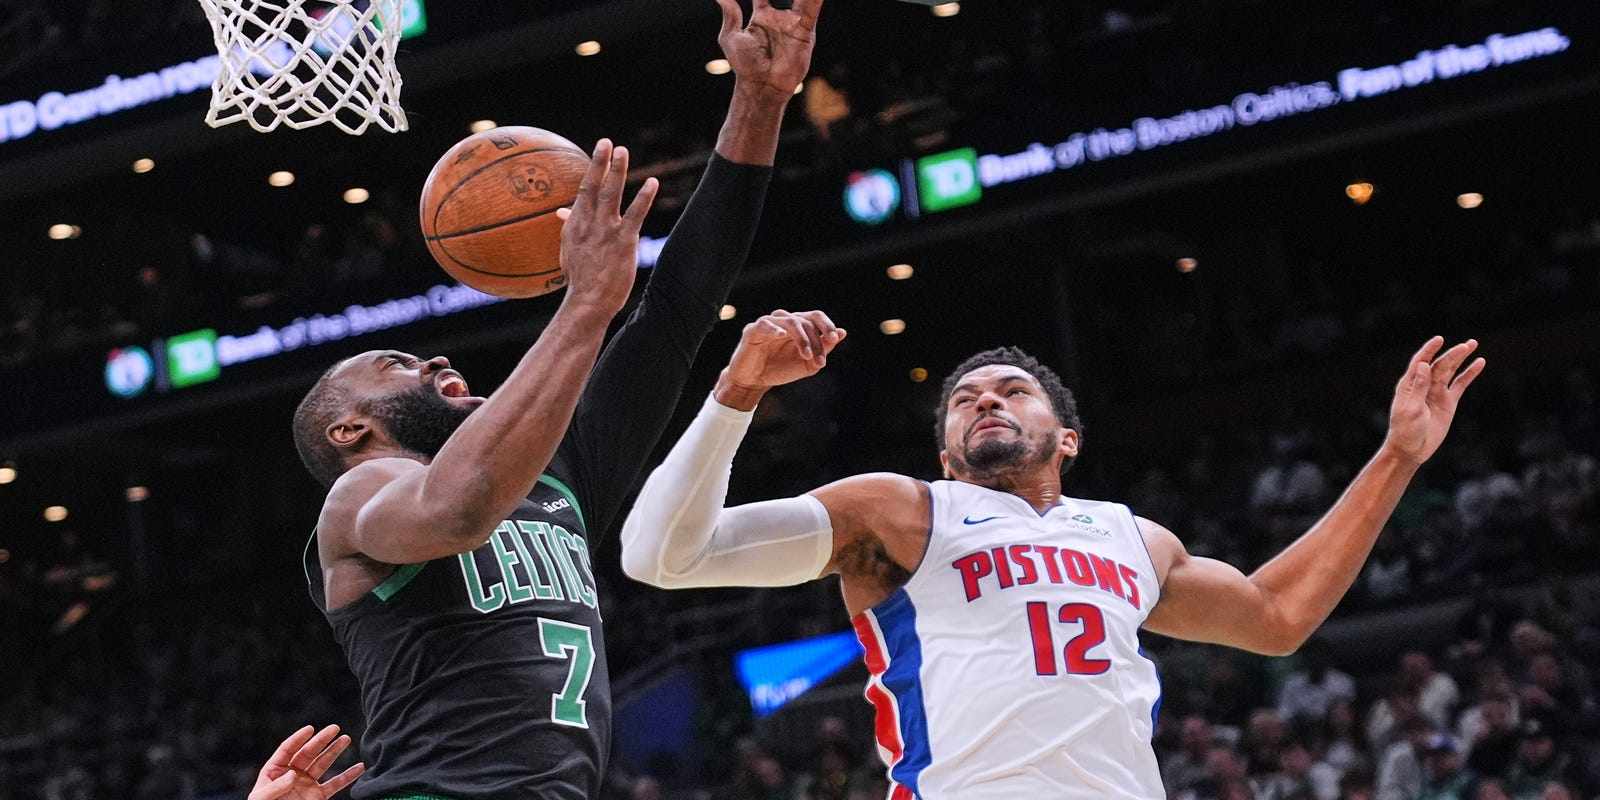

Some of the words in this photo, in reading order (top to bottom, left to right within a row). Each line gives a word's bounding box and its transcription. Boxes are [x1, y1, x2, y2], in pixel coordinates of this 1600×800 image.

[37, 74, 163, 131] Garden
[978, 143, 1055, 188] Bank
[1055, 132, 1085, 168] of
[1085, 128, 1136, 161] the
[1132, 105, 1234, 150] Boston
[1231, 81, 1341, 126] Celtics,
[1338, 67, 1401, 101] Fan
[1400, 50, 1435, 87] of
[1434, 44, 1489, 79] the
[1486, 27, 1570, 67] fans.
[926, 159, 974, 197] TD
[170, 339, 213, 373] TD
[216, 326, 281, 366] Bank
[280, 317, 307, 350] of
[306, 313, 349, 345] the
[345, 303, 431, 337] Boston
[952, 544, 1141, 610] PISTONS
[1027, 601, 1112, 675] 12
[537, 618, 596, 728] 7
